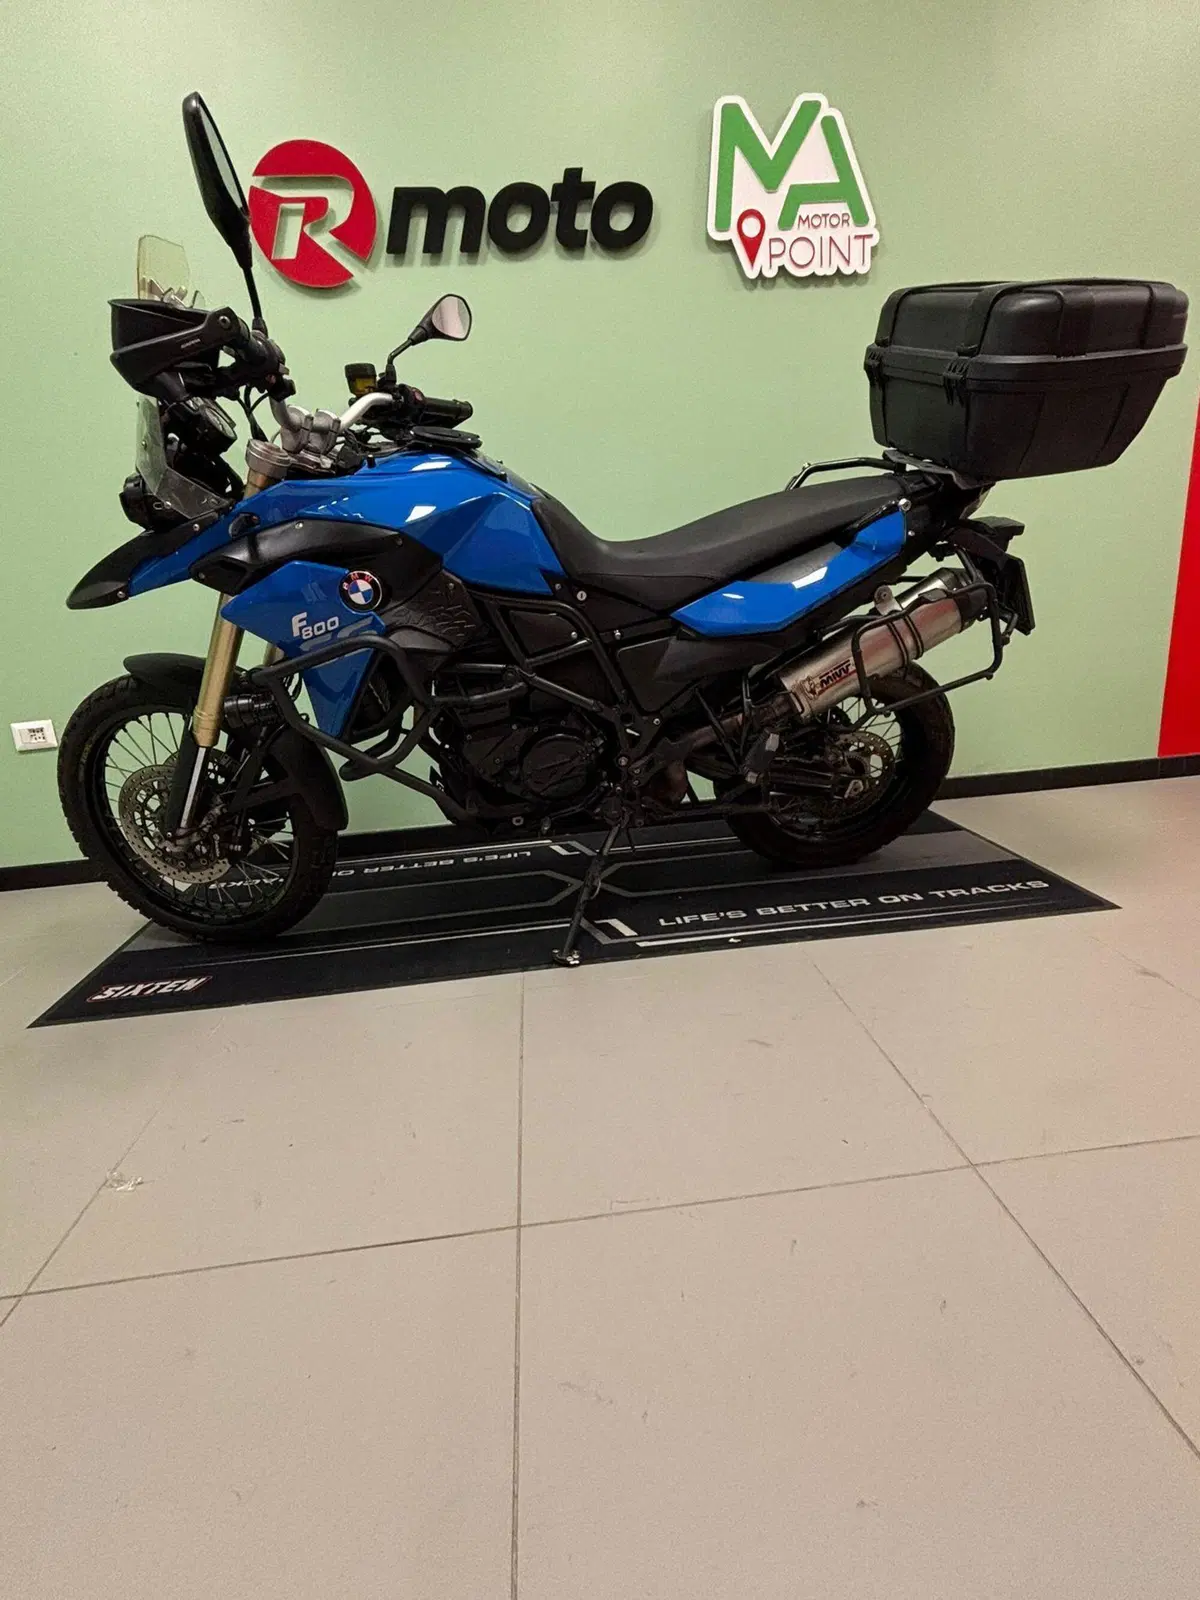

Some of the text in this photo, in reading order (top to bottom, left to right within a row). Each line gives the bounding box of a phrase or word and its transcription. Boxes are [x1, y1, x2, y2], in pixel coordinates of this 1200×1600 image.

[714, 99, 870, 232] MA
[386, 167, 653, 256] moto
[797, 212, 851, 230] MOTOR
[768, 234, 873, 270] POINT
[342, 572, 373, 591] BMW
[332, 869, 355, 877] O
[364, 859, 454, 874] BETTER
[658, 879, 1049, 927] LIFE'S BETTER ON TRACKS
[92, 977, 206, 1001] SIXTEN
